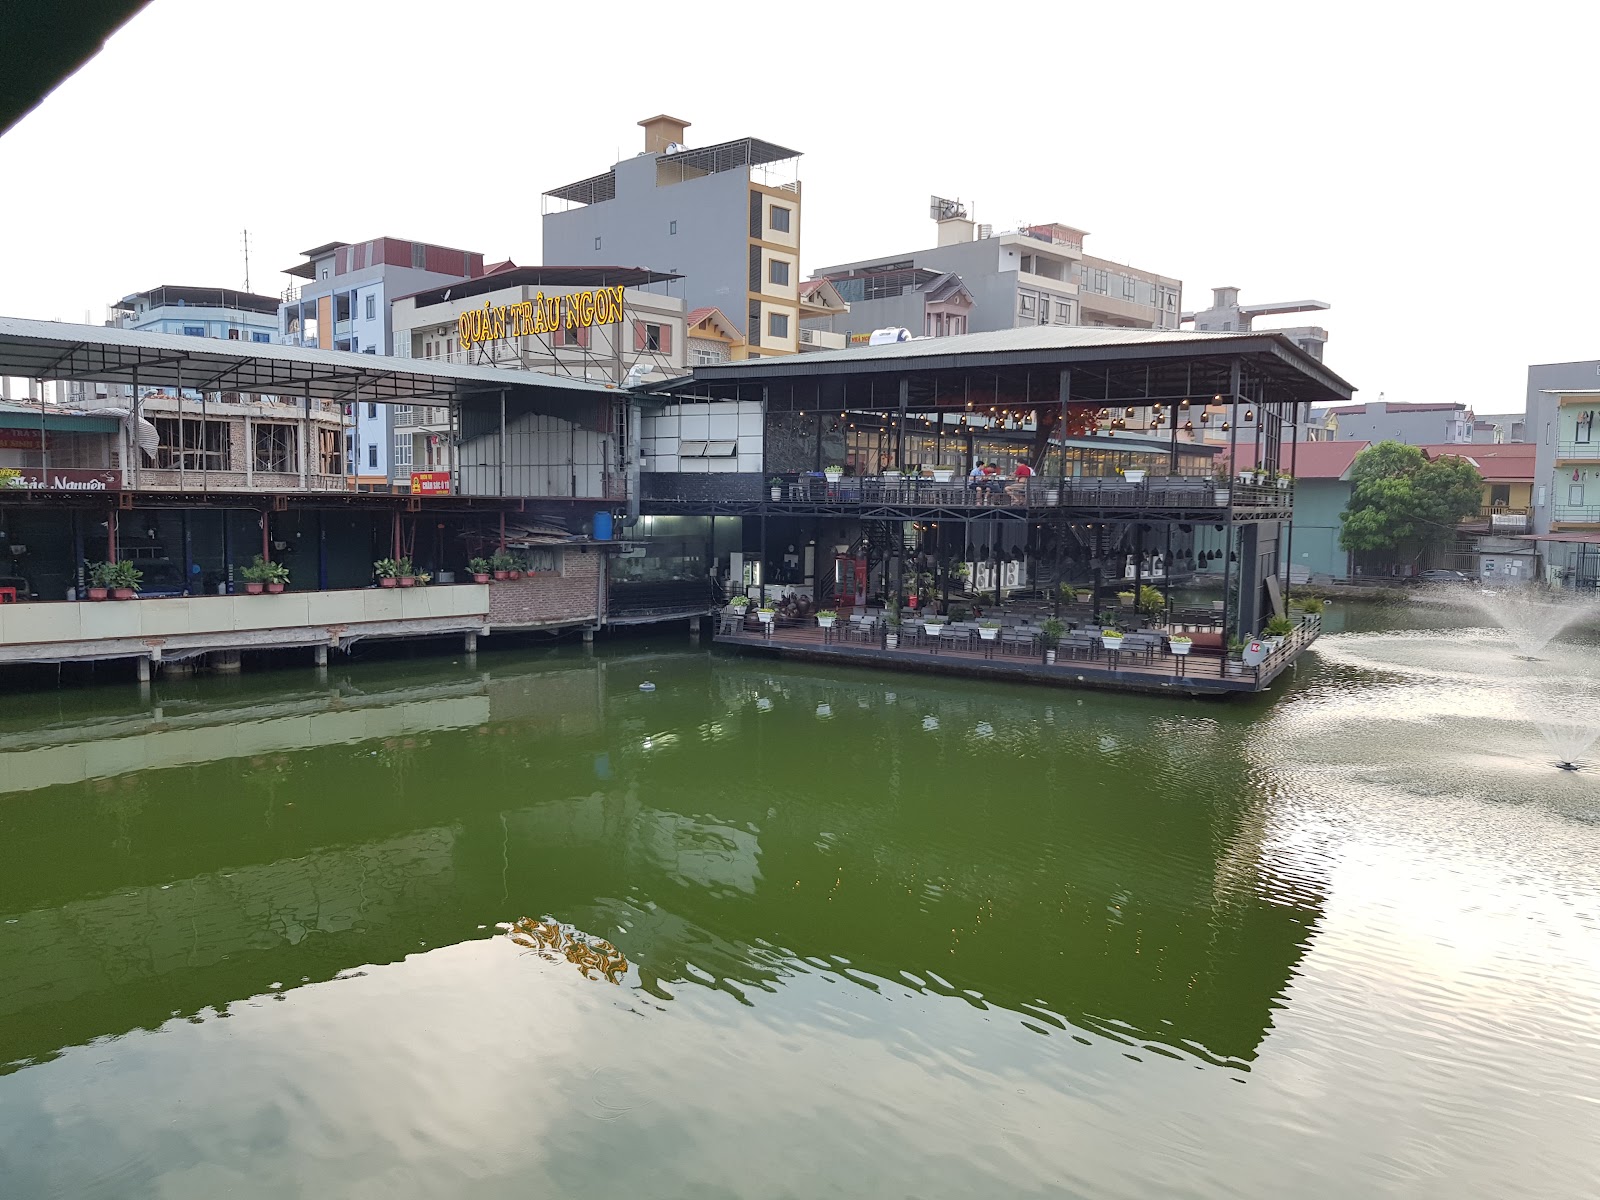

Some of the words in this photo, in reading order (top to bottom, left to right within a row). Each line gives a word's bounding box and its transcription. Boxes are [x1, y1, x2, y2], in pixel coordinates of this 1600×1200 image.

[458, 300, 506, 350] QUÁN
[511, 291, 561, 337] TRÂU
[566, 285, 624, 330] NGON
